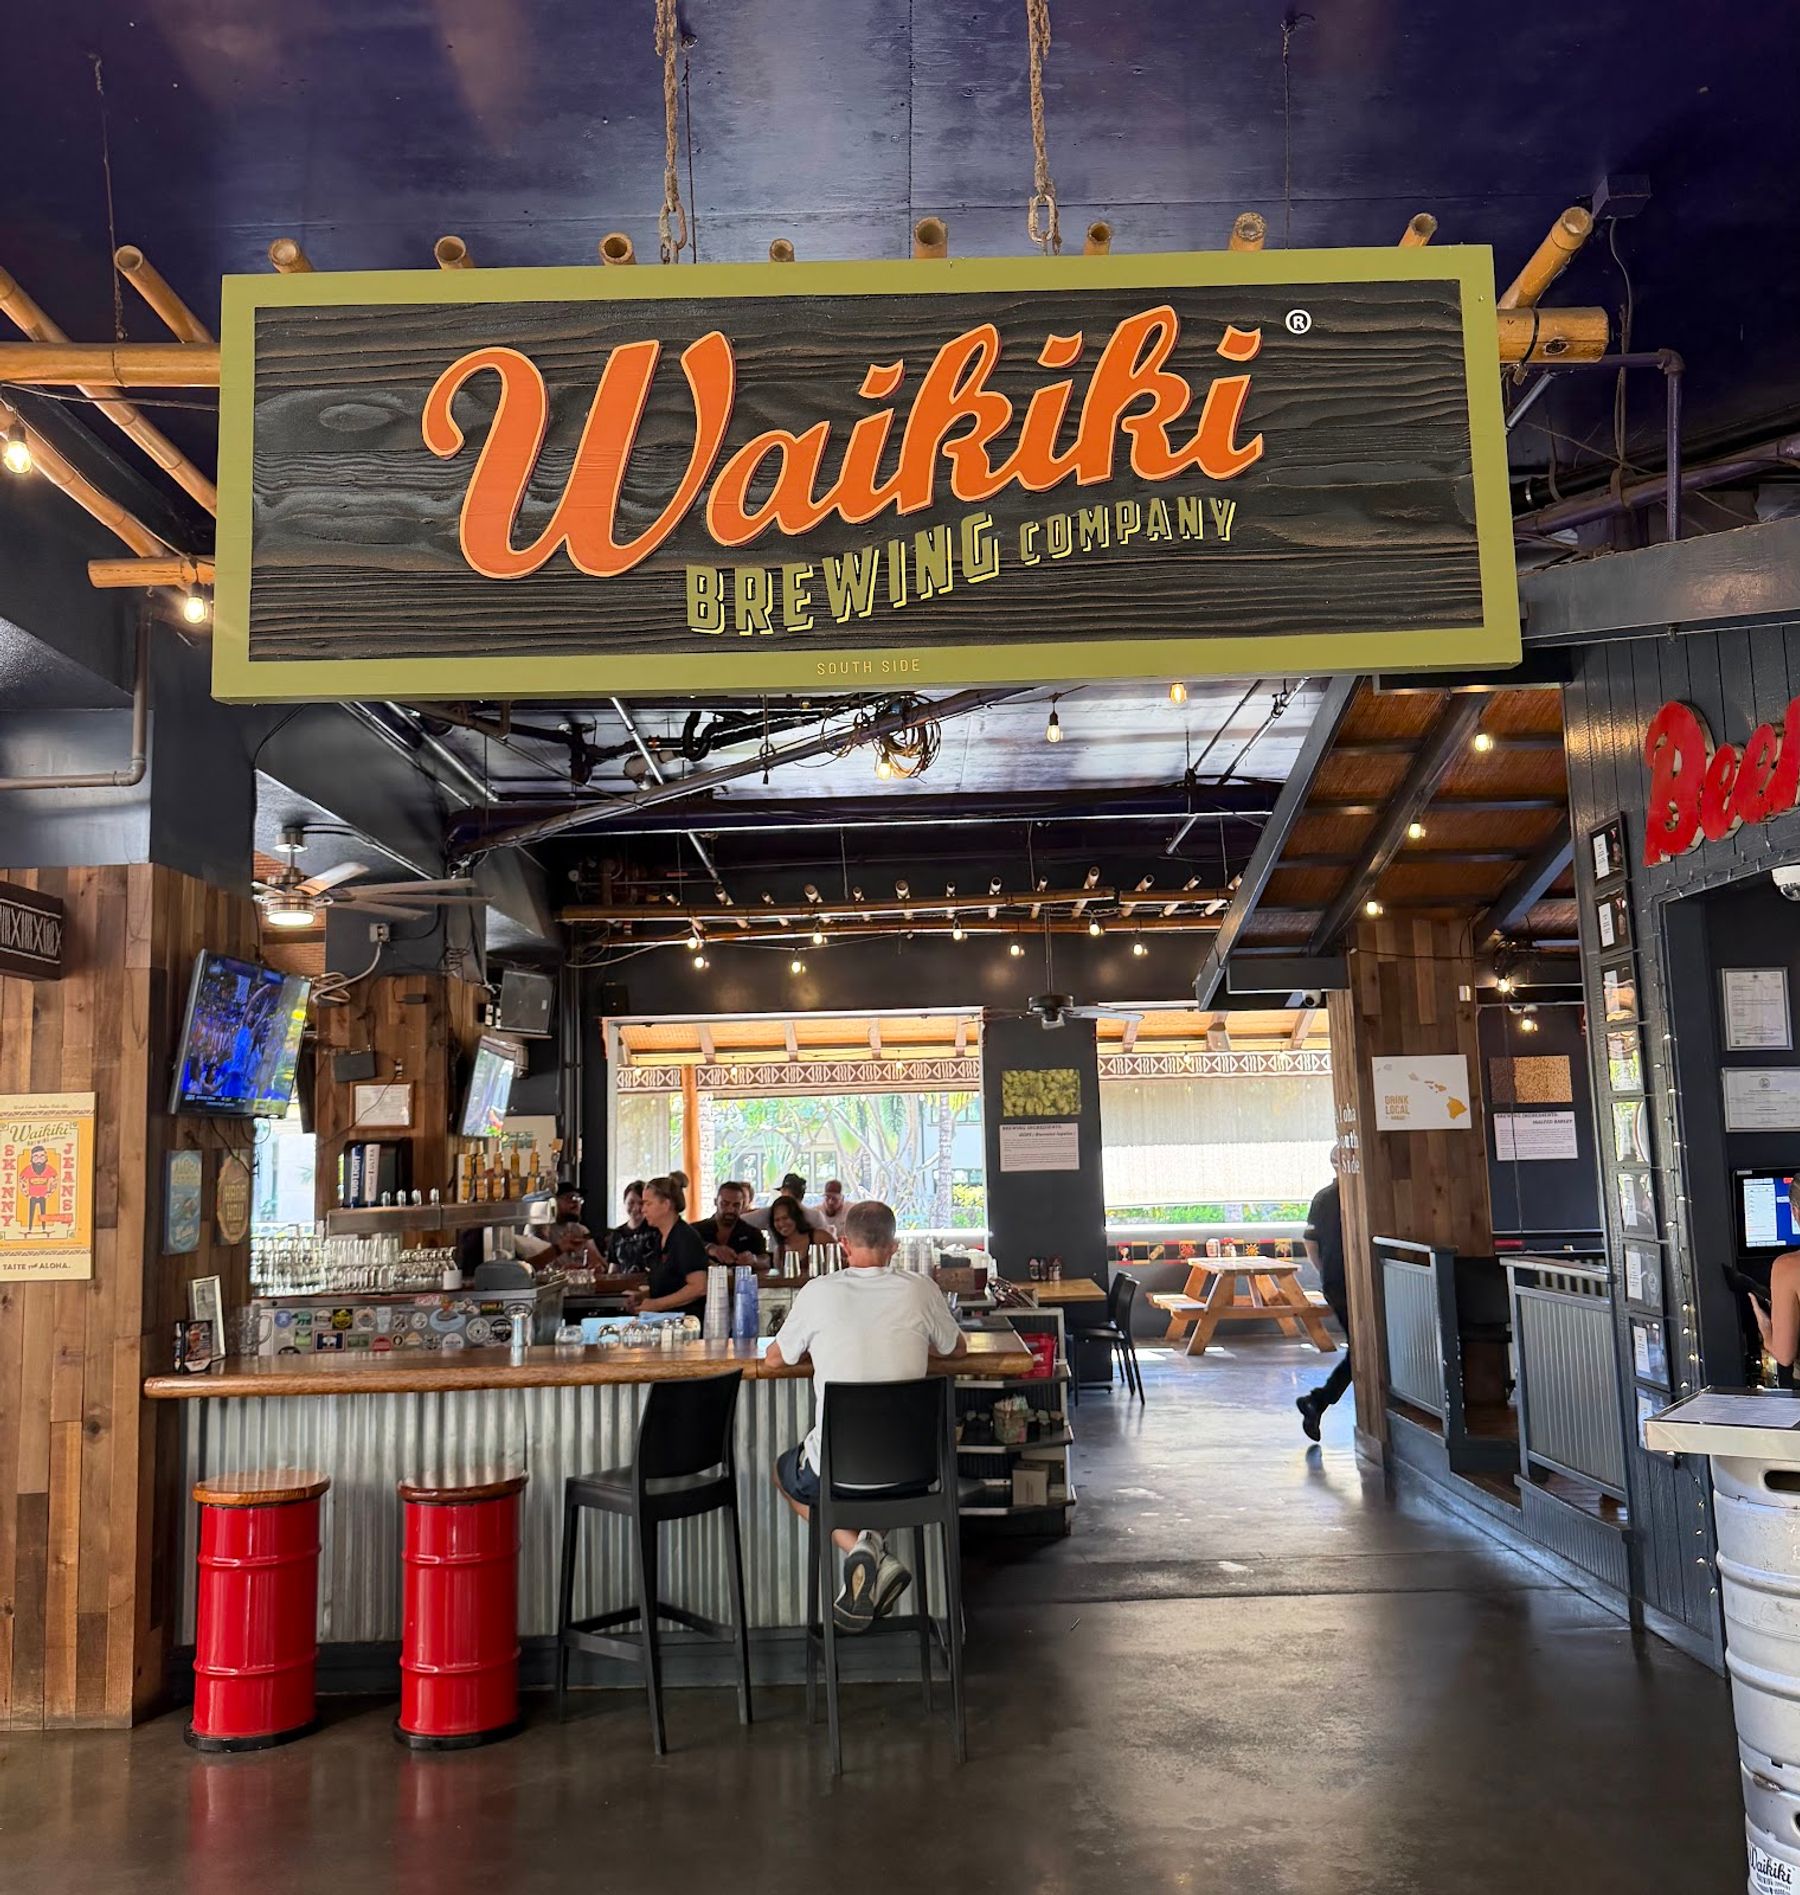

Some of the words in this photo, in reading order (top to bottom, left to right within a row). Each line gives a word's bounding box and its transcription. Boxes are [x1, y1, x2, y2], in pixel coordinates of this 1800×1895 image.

[422, 304, 1264, 580] Waikiki
[685, 511, 1000, 636] BREWING
[1019, 496, 1237, 566] COMPANY
[817, 660, 872, 675] SOUTH
[881, 658, 920, 673] SIDE
[1384, 1095, 1409, 1105] DRINK
[1385, 1105, 1410, 1115] LOCAL
[9, 1122, 69, 1143] Waikiki
[1, 1144, 16, 1227] SKINNY
[62, 1142, 75, 1212] JEANS
